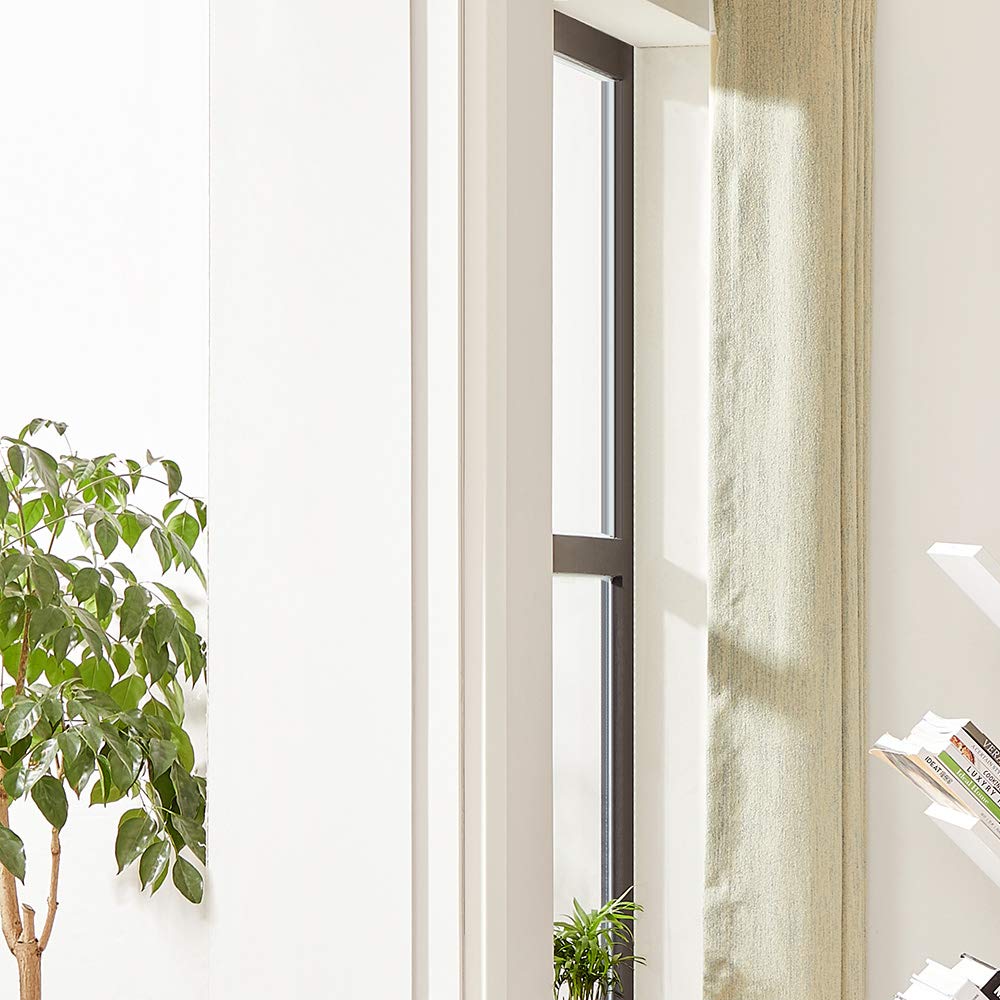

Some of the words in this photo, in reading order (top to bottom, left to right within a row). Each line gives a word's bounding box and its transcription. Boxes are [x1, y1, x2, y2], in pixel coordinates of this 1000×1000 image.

[925, 756, 942, 773] IDEAT
[955, 768, 973, 787] Ideal
[971, 783, 991, 805] Home
